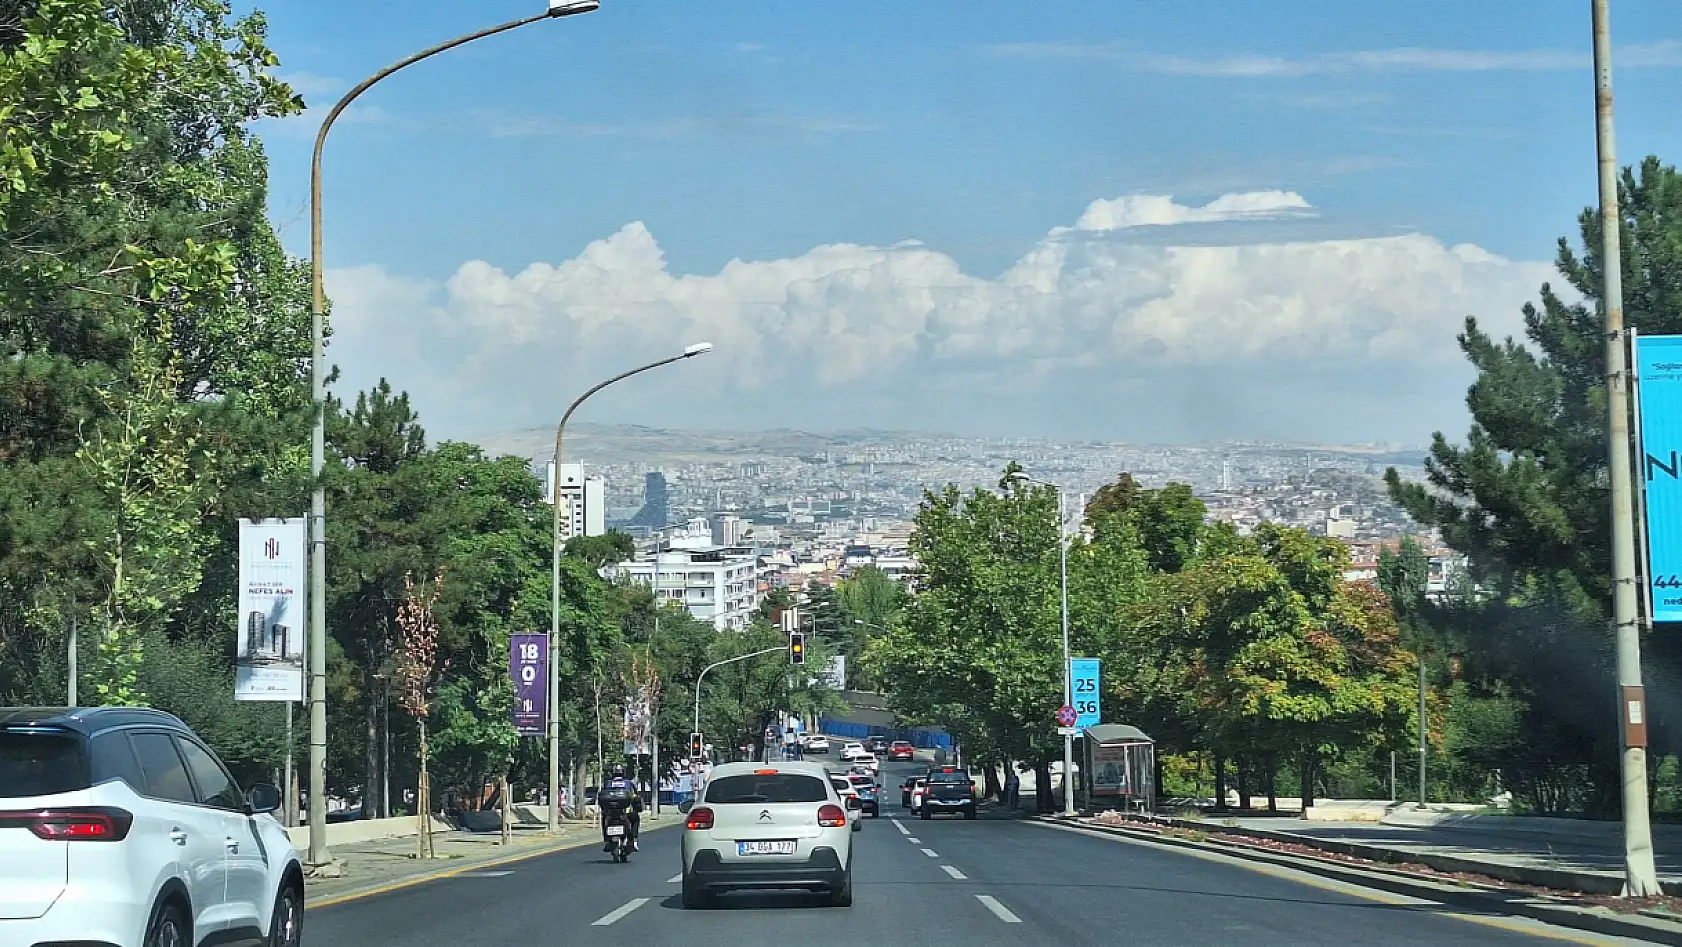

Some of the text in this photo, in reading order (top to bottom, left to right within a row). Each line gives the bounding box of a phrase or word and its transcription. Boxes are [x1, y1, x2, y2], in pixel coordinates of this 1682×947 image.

[1646, 451, 1682, 480] N
[1653, 575, 1682, 588] 44
[519, 644, 538, 659] 18
[1076, 678, 1096, 692] 25
[1076, 700, 1097, 714] 36
